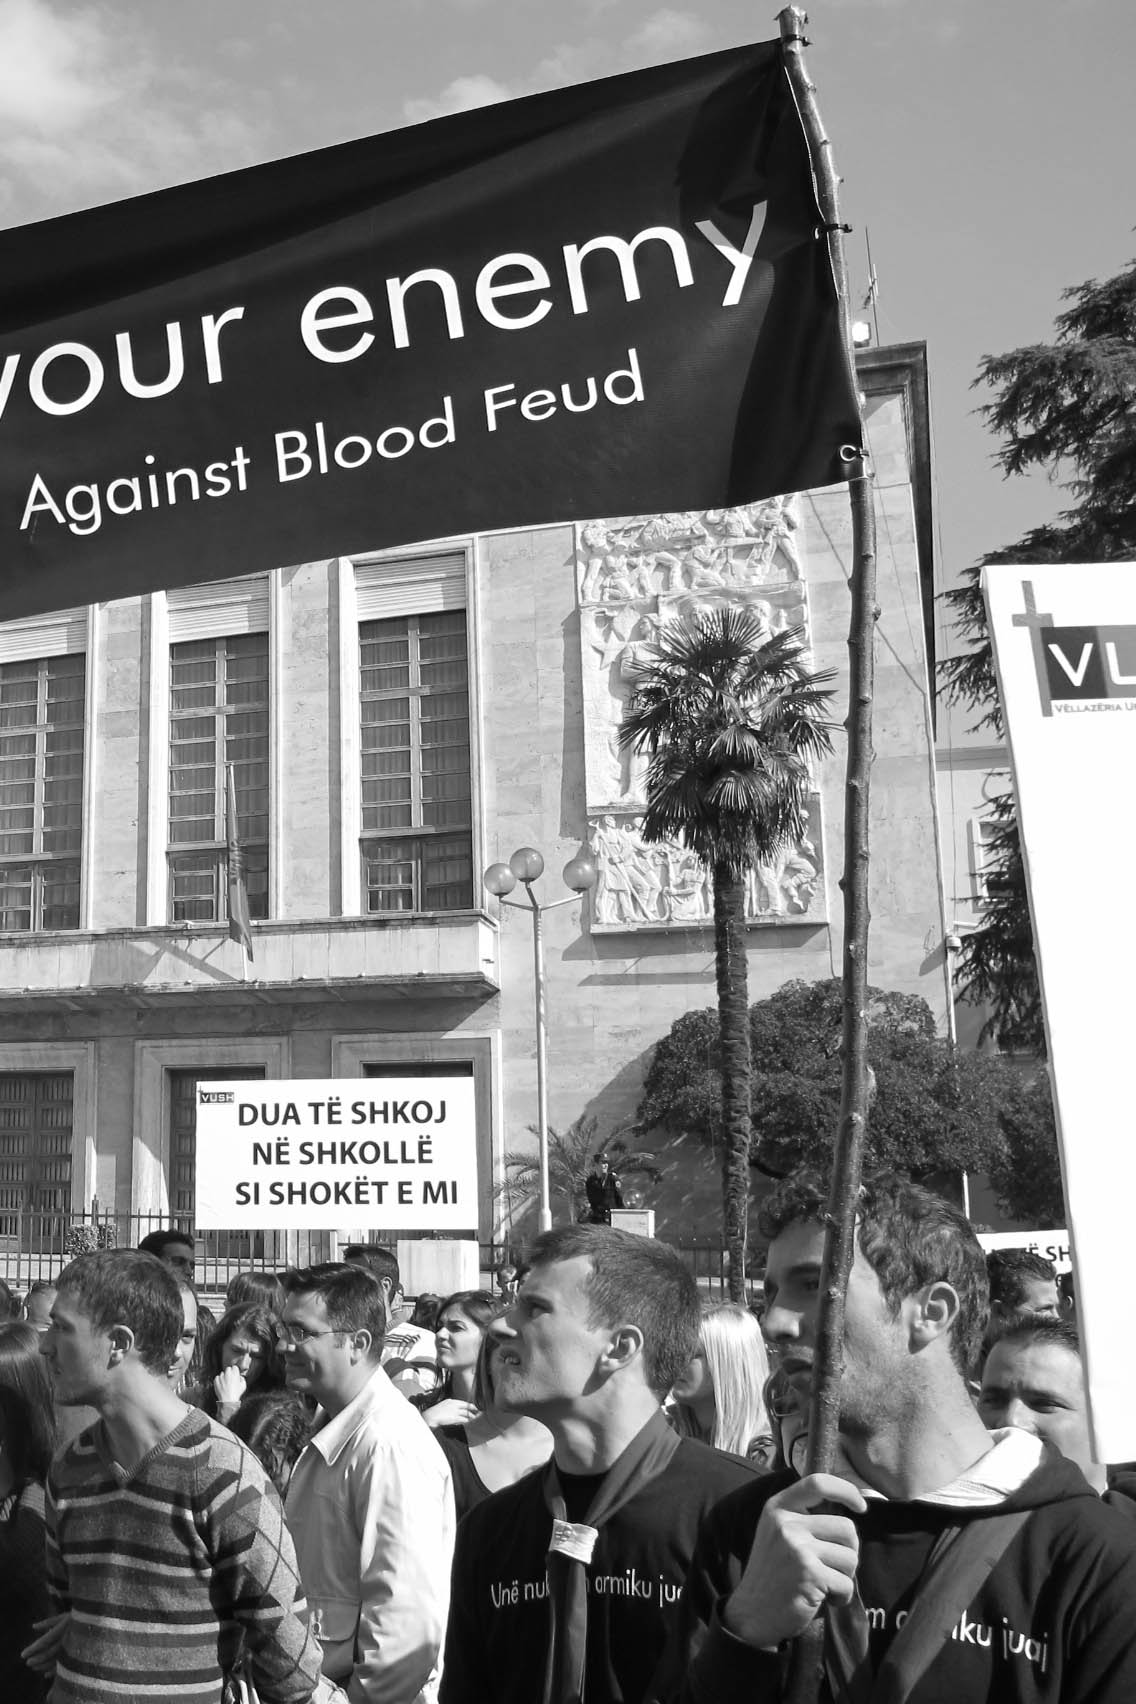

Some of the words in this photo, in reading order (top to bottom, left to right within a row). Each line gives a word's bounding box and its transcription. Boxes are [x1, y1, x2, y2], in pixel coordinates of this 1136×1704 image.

[300, 200, 768, 364] enemy
[20, 447, 252, 536] Against
[274, 396, 456, 483] Blood
[483, 348, 646, 433] Feud
[201, 1094, 234, 1102] VUSH
[238, 1103, 301, 1126] DUA
[308, 1096, 342, 1125] TË
[351, 1100, 446, 1125] SHKOJ
[253, 1136, 290, 1166] NË
[299, 1135, 433, 1165] SHKOLLË
[235, 1181, 260, 1206] SI
[269, 1175, 389, 1205] SHOKËT
[398, 1181, 413, 1205] E
[422, 1180, 458, 1205] MI
[490, 1579, 519, 1609] Unë
[595, 1568, 652, 1598] armiku
[1001, 1617, 1049, 1673] juaj
